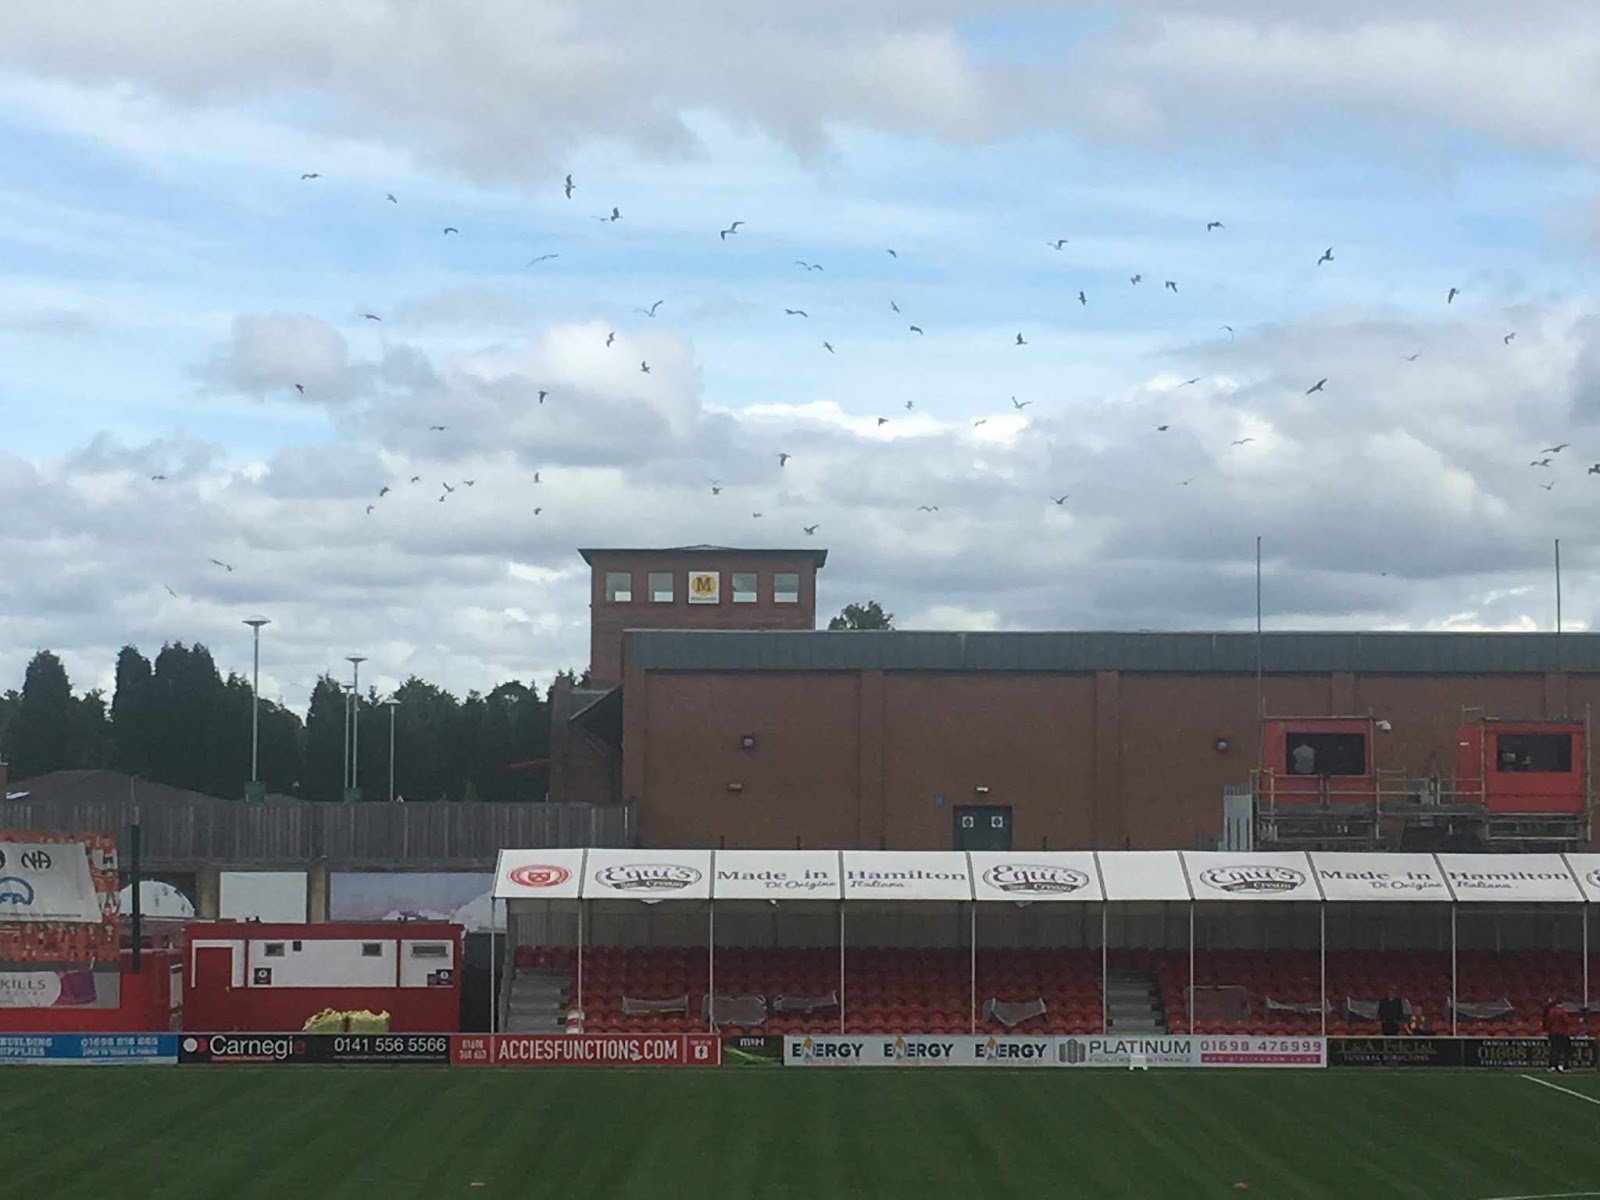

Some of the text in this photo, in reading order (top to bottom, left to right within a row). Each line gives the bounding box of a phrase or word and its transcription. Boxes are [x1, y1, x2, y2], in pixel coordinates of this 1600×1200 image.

[695, 577, 712, 592] M
[717, 869, 828, 880] Made in
[847, 870, 967, 881] Hamilton
[1320, 870, 1431, 880] Made in
[1449, 871, 1569, 880] Hamilton
[334, 1038, 447, 1052] 0141 556 5566
[499, 1039, 677, 1060] ACCIESFUNCTIONS.COM
[792, 1040, 864, 1058] ENERGY
[884, 1040, 954, 1058] ENERGY
[975, 1040, 1047, 1058] ENERGY
[1089, 1040, 1191, 1054] PLATINUM
[1200, 1040, 1322, 1052] 01698 476999
